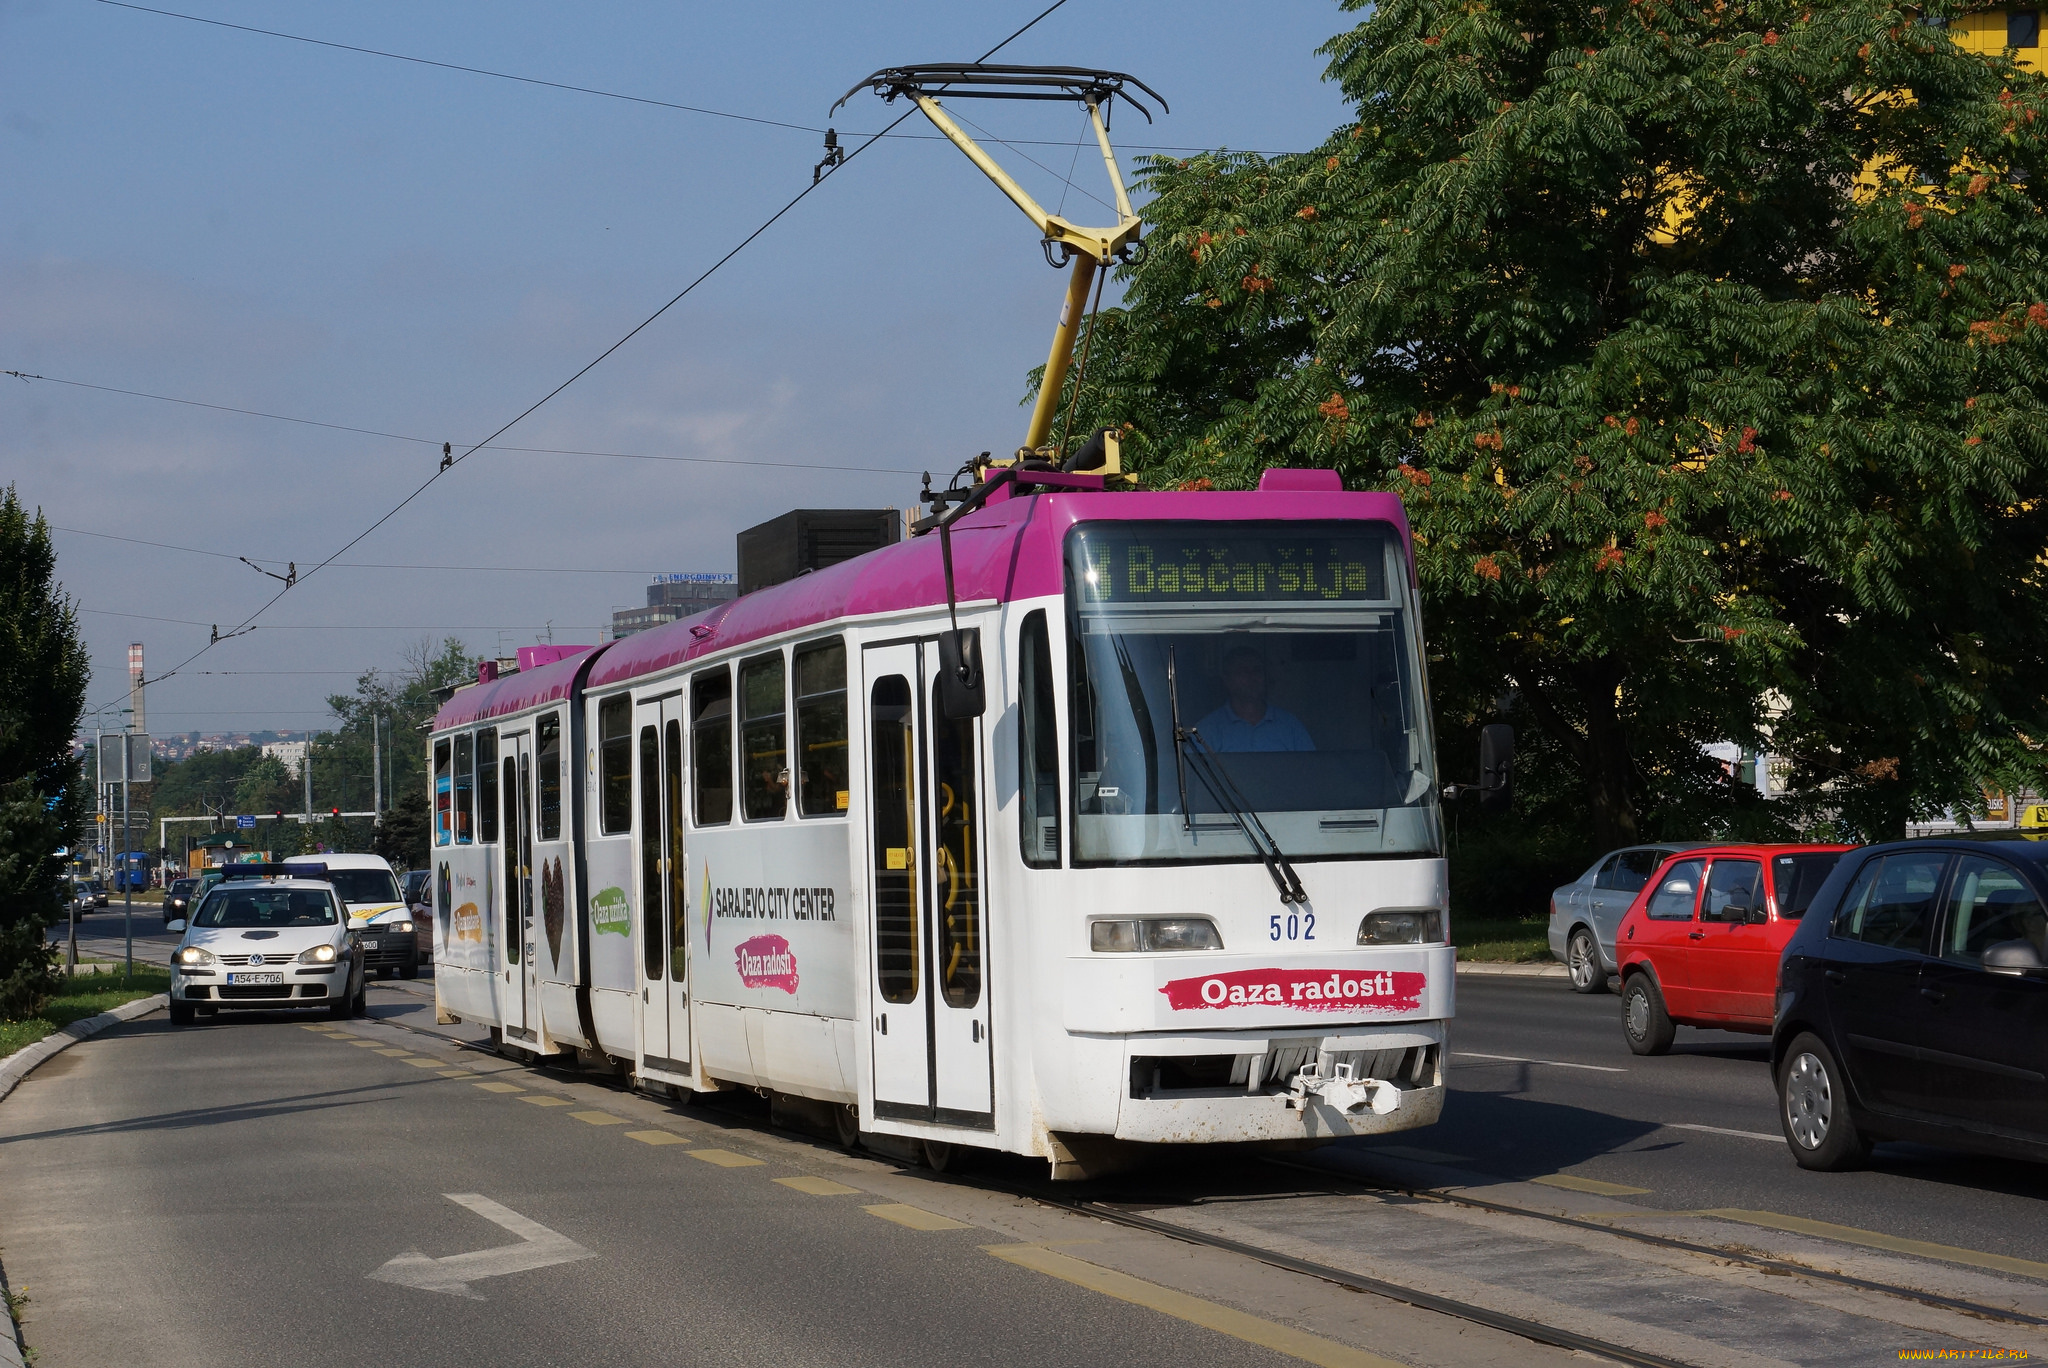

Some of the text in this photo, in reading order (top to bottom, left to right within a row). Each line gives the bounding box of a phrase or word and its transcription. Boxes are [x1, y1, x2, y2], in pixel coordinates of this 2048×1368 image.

[668, 573, 733, 581] ENERGOINVEST
[1128, 545, 1367, 598] Baščaršija
[716, 887, 836, 921] SARAJEVO CITY CENTER
[1270, 913, 1315, 941] 502
[741, 945, 792, 977] Oaza radosti
[234, 974, 281, 984] A54-E-706
[1201, 970, 1395, 1004] Oaza radosti
